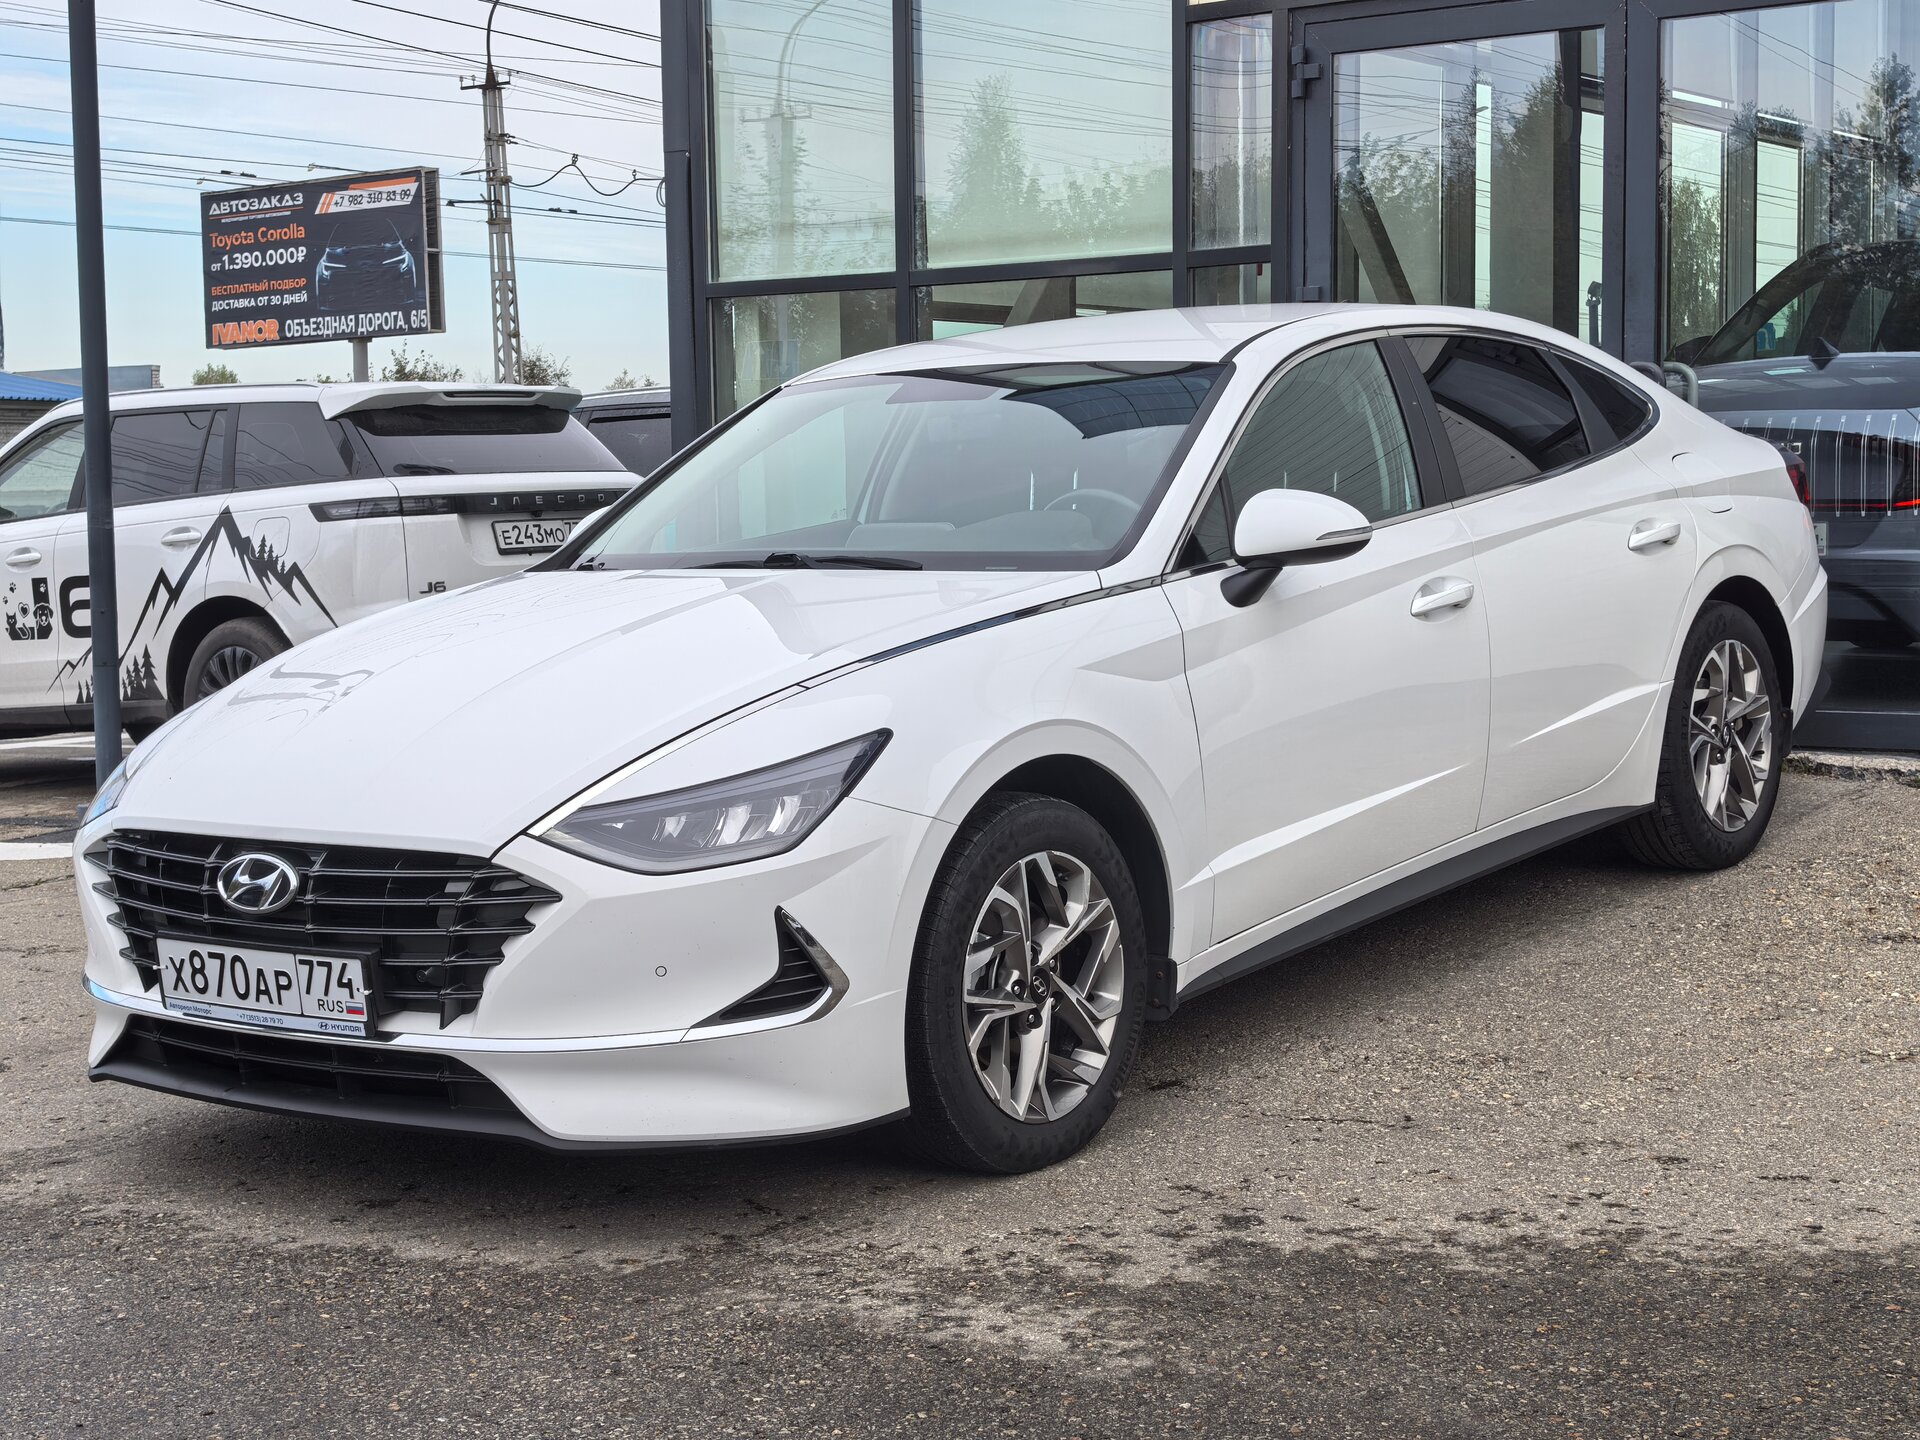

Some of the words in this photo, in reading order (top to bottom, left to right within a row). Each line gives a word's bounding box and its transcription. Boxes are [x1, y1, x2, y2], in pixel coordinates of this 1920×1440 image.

[208, 192, 304, 215] АВТОЗАКАЗ
[334, 196, 344, 208] +7
[348, 194, 364, 207] 982
[367, 192, 383, 204] 310
[386, 190, 397, 202] 83
[400, 188, 411, 200] 09
[209, 230, 255, 250] Toyota
[257, 222, 305, 243] Corolla
[211, 262, 221, 272] от
[211, 279, 268, 296] БЕСПЛАТНЫЙ
[270, 277, 307, 291] ПОДБОР
[211, 297, 256, 312] ДОСТАВКА
[257, 296, 269, 306] ОТ
[270, 295, 282, 305] 30
[283, 290, 308, 306] ДНЕЙ
[211, 318, 280, 346] IVANOR
[285, 314, 356, 338] ОБЪЕЗДНАЯ
[357, 310, 408, 336] ДОРОГА,
[410, 309, 427, 328] 6/5
[419, 580, 447, 594] J6
[168, 949, 292, 1006] Х870АР
[298, 958, 355, 1000] 774
[317, 998, 344, 1014] RUS
[330, 1023, 363, 1033] HYUNDAI
